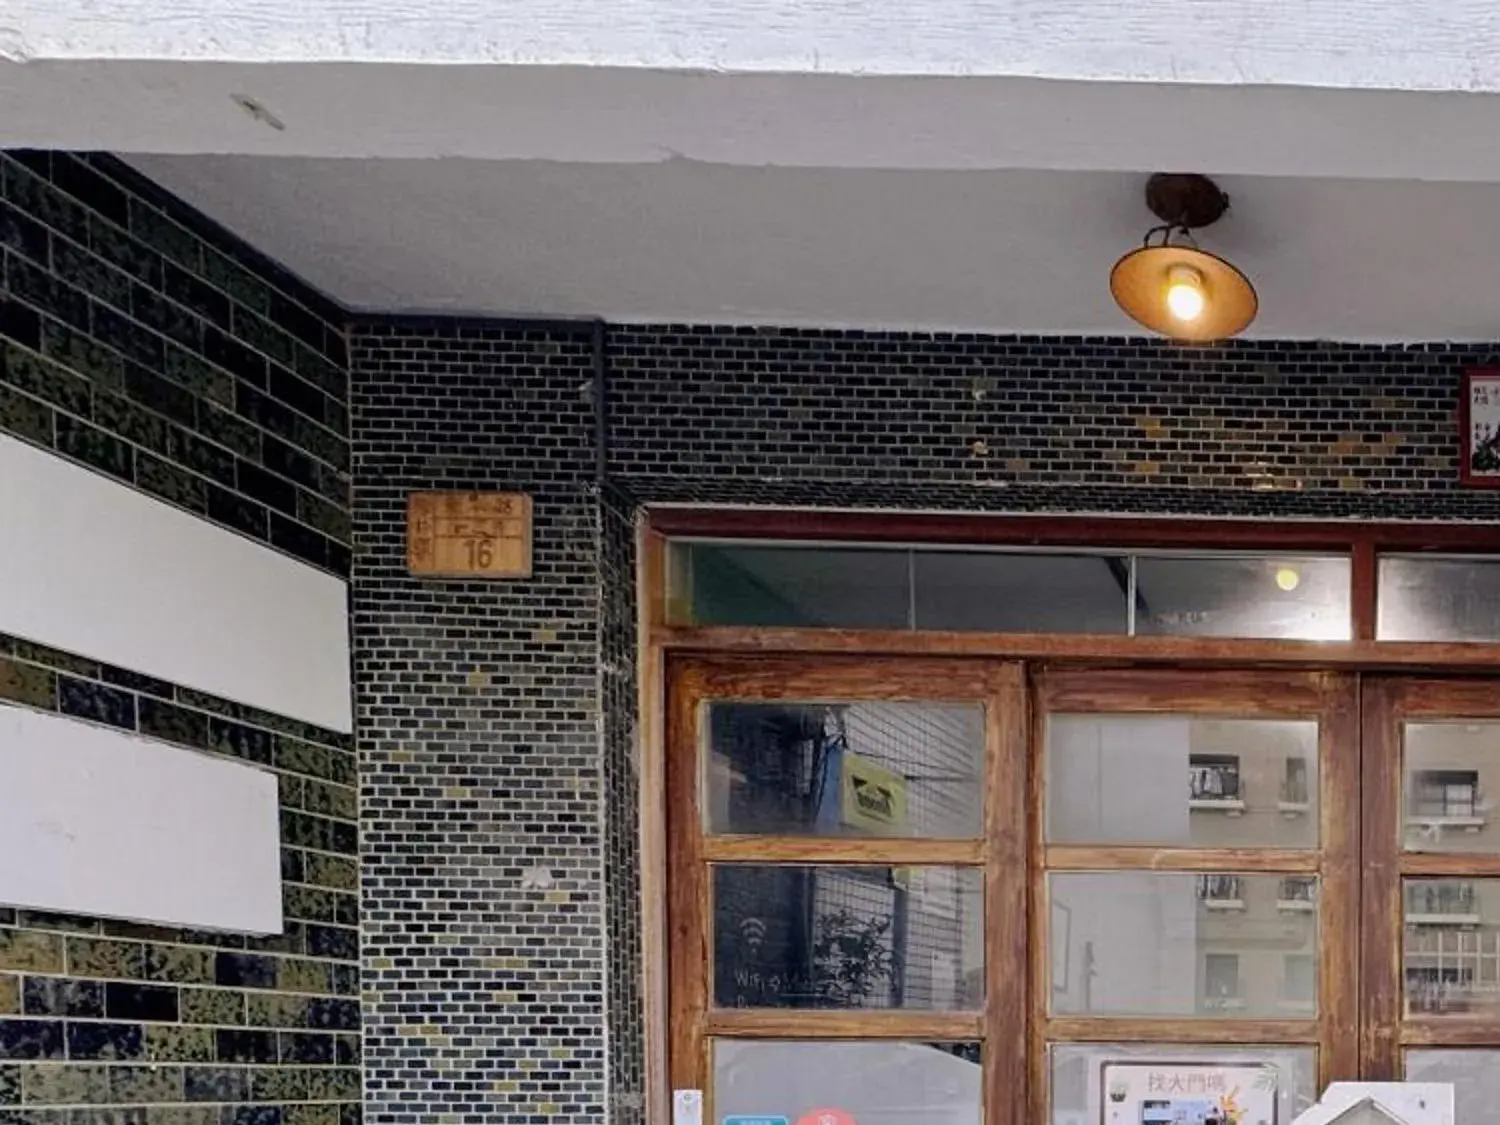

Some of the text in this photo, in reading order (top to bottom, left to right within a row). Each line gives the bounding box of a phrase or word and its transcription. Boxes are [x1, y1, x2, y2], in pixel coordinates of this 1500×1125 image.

[464, 540, 493, 570] 16
[1148, 1071, 1227, 1093] 找大門嗎
